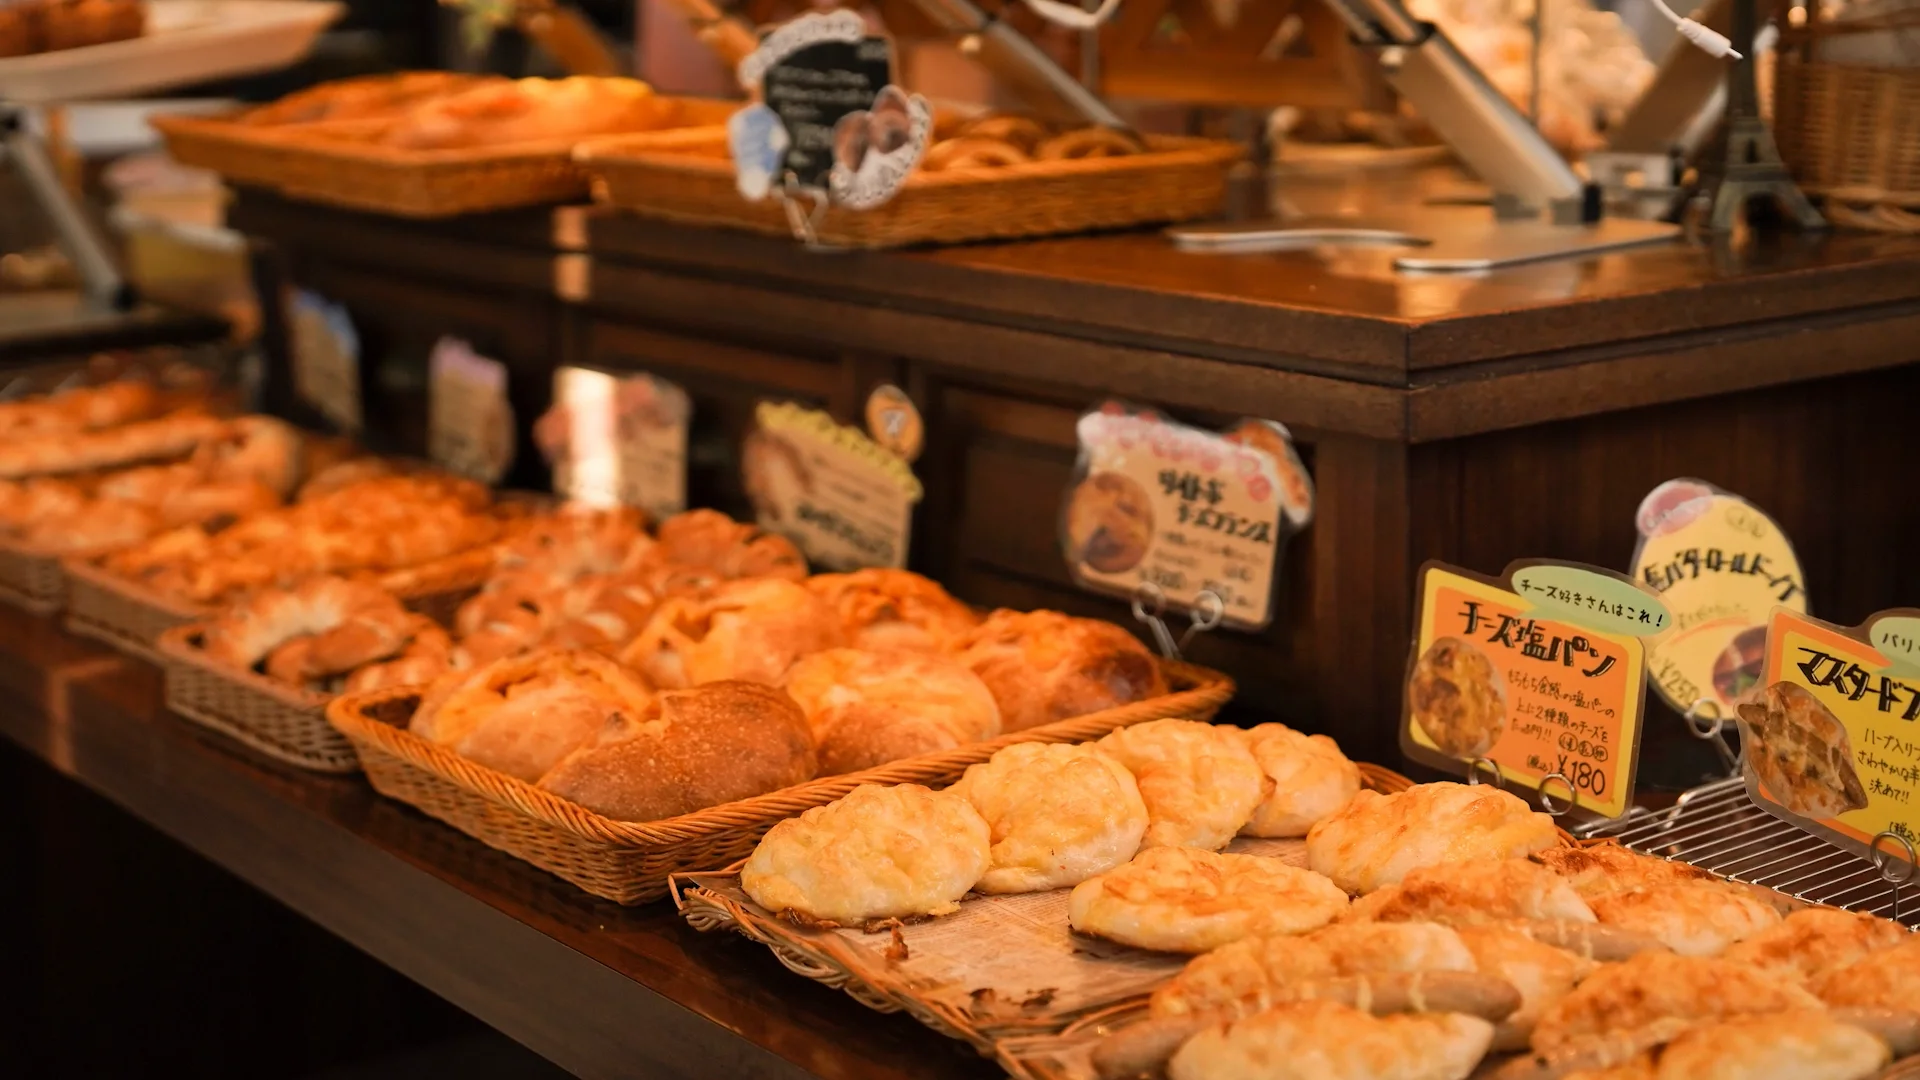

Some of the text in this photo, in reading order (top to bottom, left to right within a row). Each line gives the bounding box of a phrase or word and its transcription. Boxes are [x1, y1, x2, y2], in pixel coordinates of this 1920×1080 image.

[1521, 579, 1663, 627] チーズ好きさんはこれ！
[1458, 601, 1617, 678] チーズ塩パン
[1882, 632, 1920, 654] パリ
